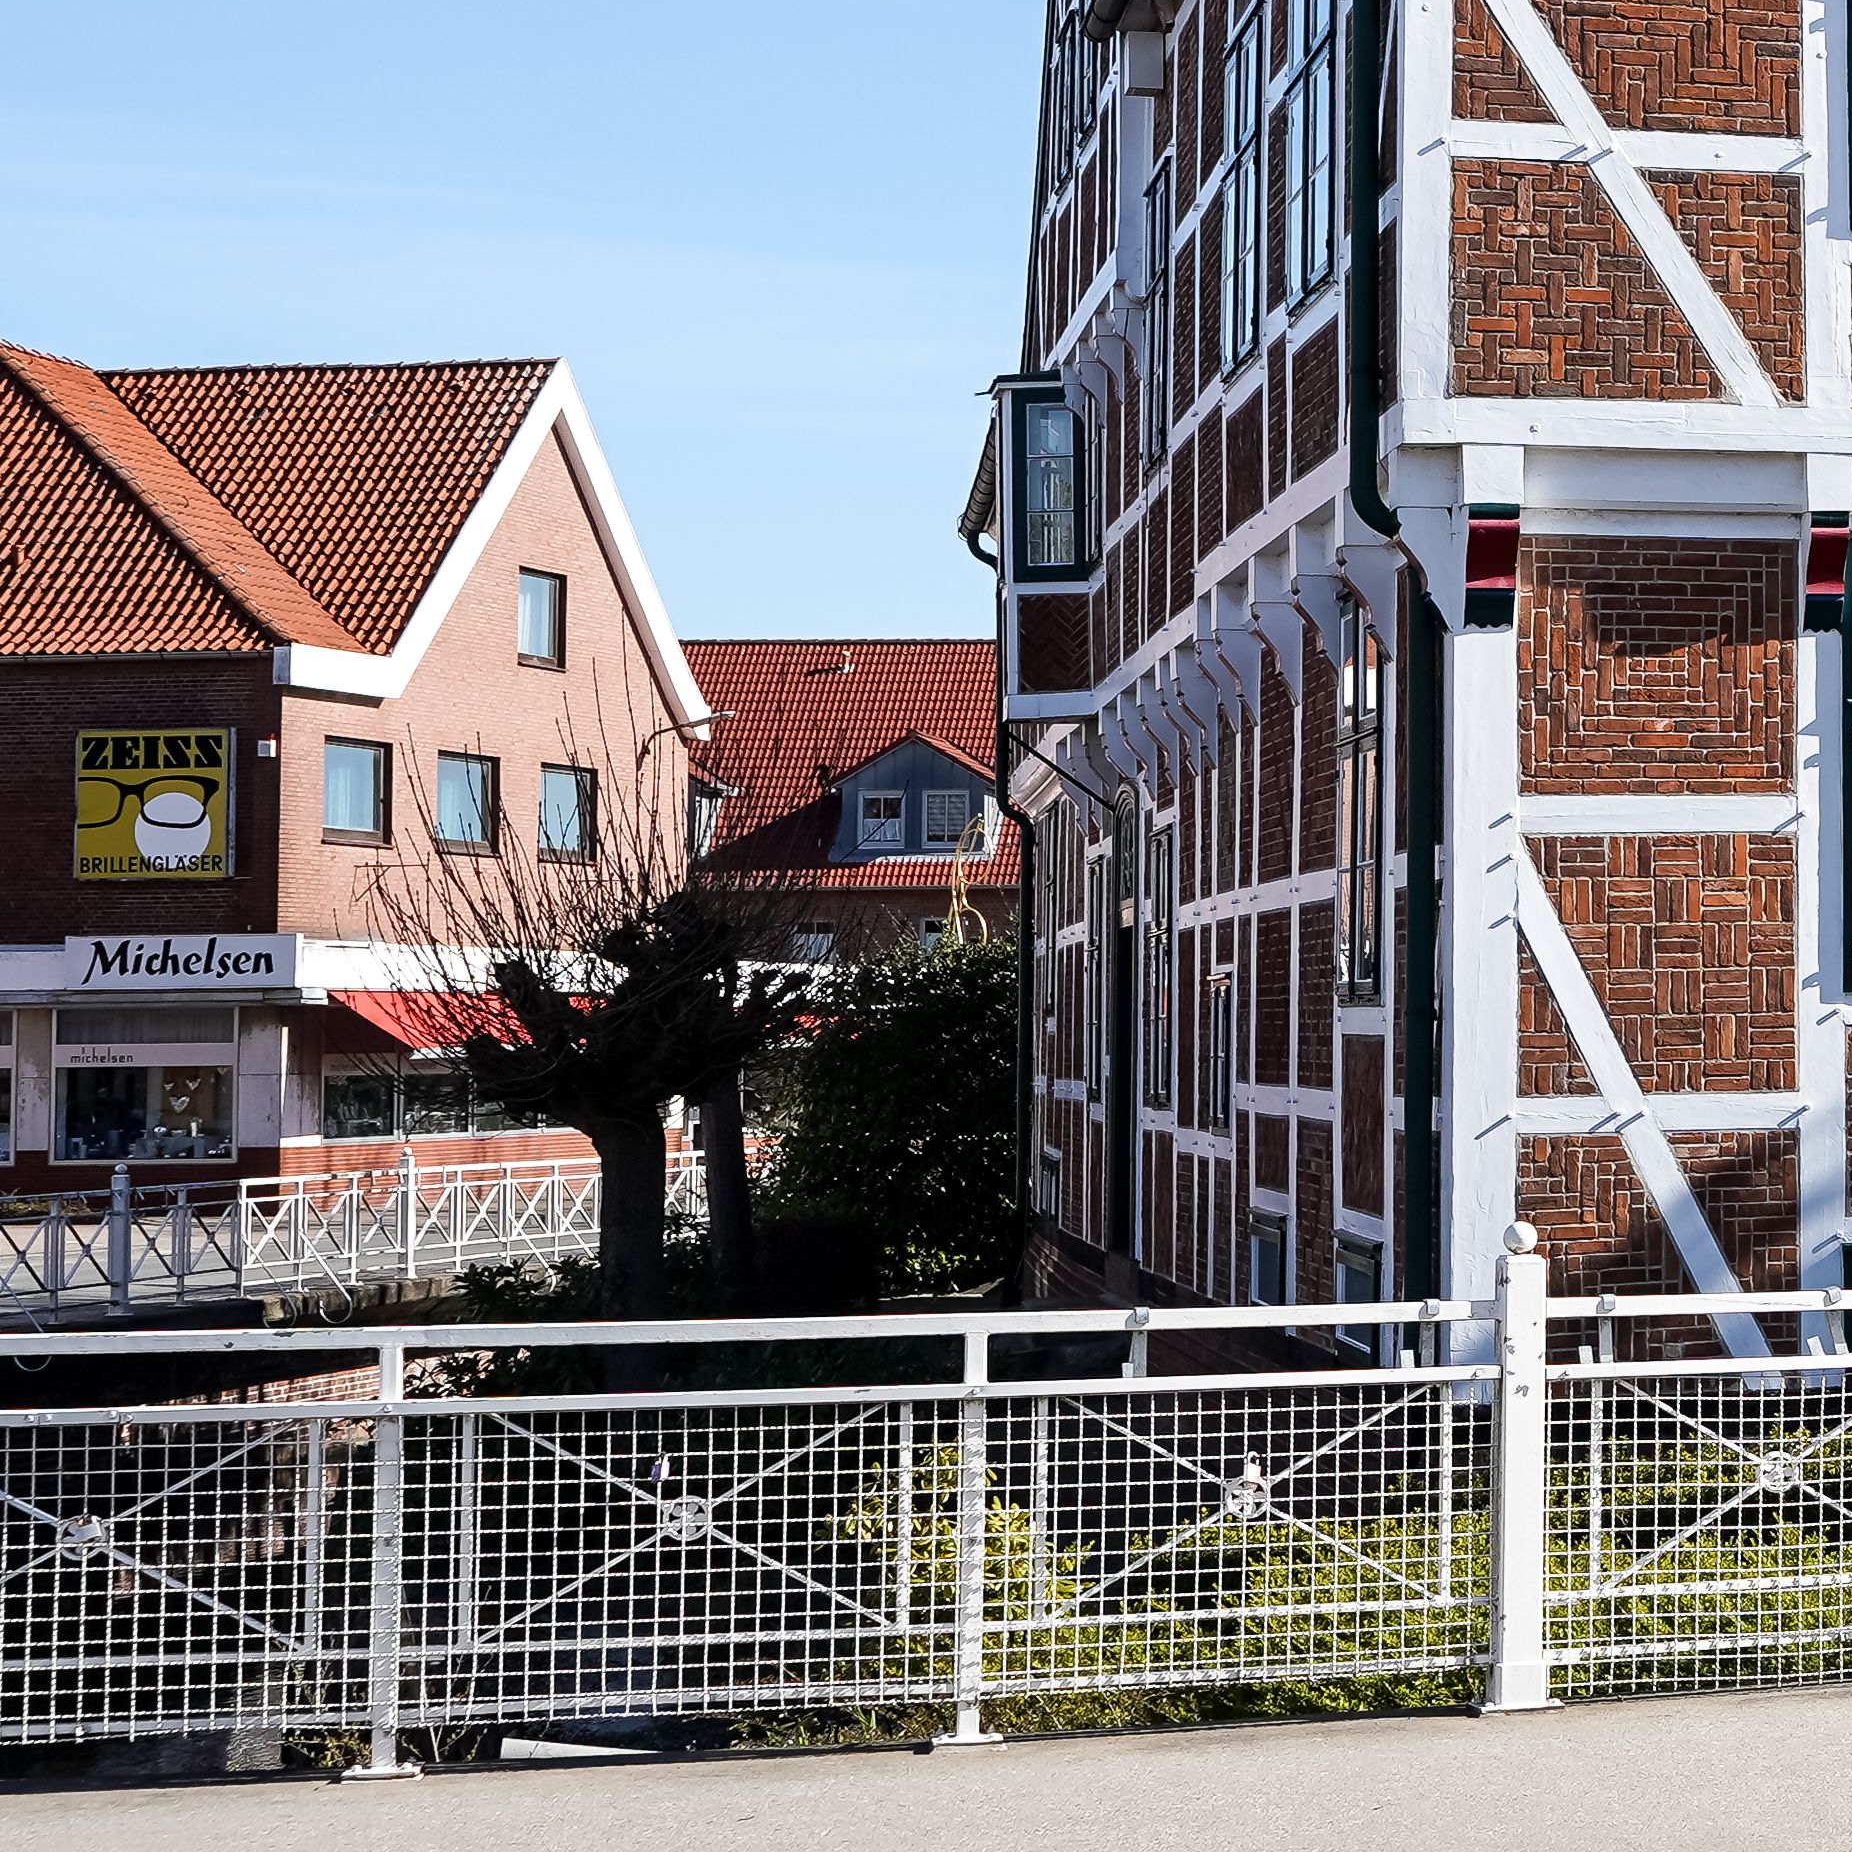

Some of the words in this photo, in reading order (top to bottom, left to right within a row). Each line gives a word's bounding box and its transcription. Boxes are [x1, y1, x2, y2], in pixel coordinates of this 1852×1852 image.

[82, 735, 222, 770] ZEISS
[80, 854, 223, 874] BRILLENGLÄSER
[81, 937, 274, 985] Michelsen
[70, 1047, 134, 1064] michelsen
